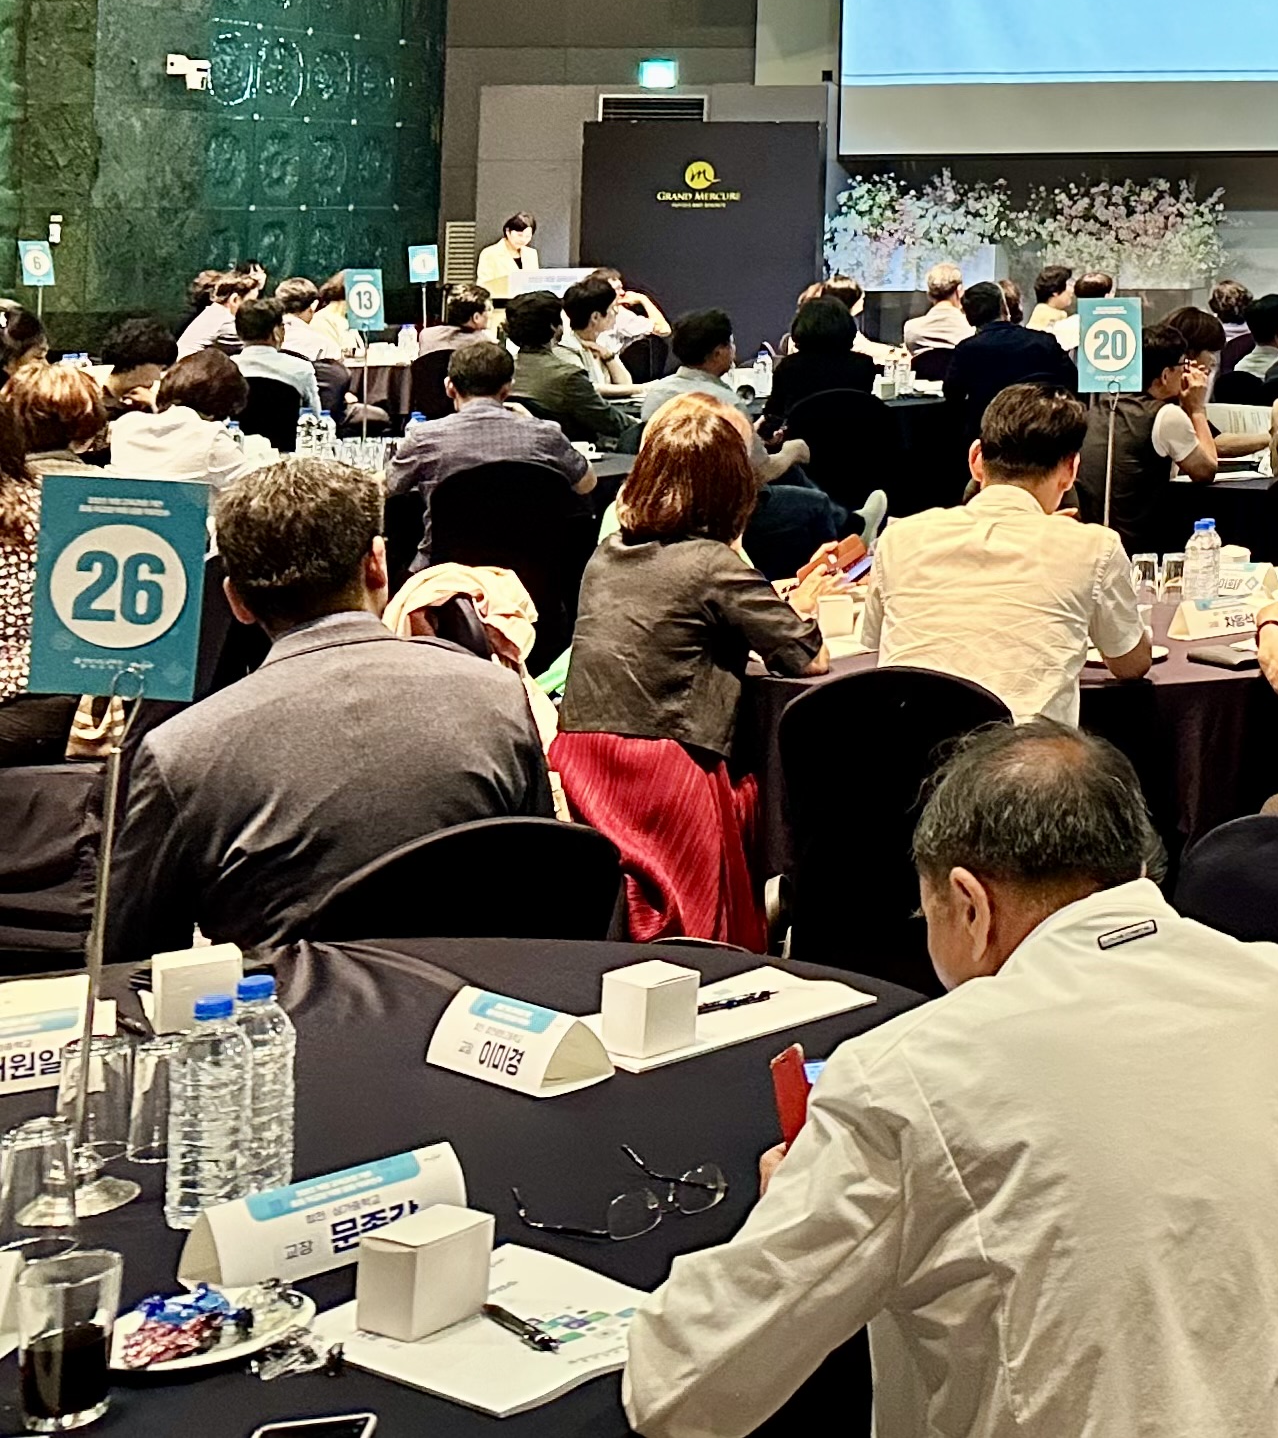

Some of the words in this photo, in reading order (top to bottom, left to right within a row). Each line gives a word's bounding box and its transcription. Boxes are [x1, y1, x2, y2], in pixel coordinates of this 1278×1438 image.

[656, 191, 693, 201] GRAND
[33, 256, 42, 270] 6
[356, 290, 373, 310] 13
[1093, 329, 1128, 361] 20
[71, 550, 167, 627] 26
[478, 1040, 526, 1076] 이미경
[283, 1239, 314, 1259] 교장
